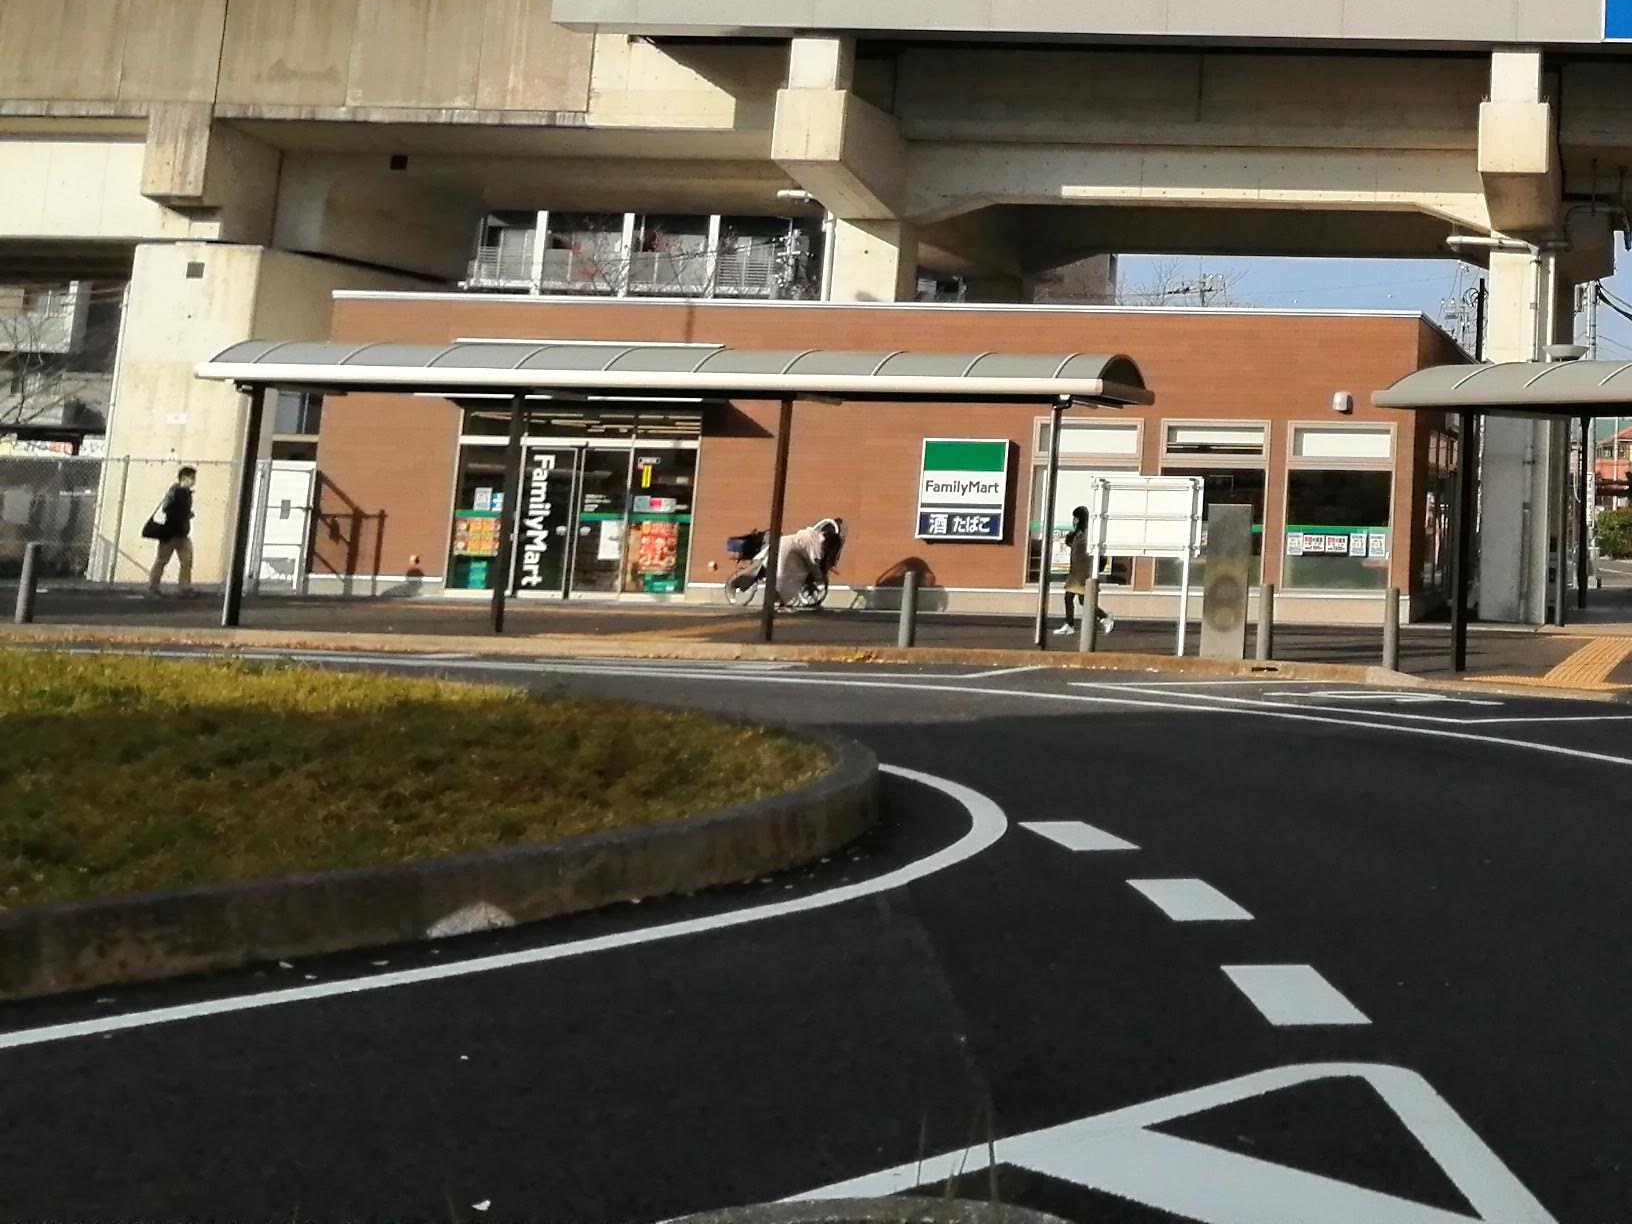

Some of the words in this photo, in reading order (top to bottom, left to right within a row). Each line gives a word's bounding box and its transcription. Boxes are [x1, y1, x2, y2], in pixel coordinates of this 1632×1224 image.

[925, 479, 999, 496] FamilyMart
[521, 454, 556, 586] FamilyMart
[929, 514, 948, 534] 酒
[953, 516, 991, 533] たばこ
